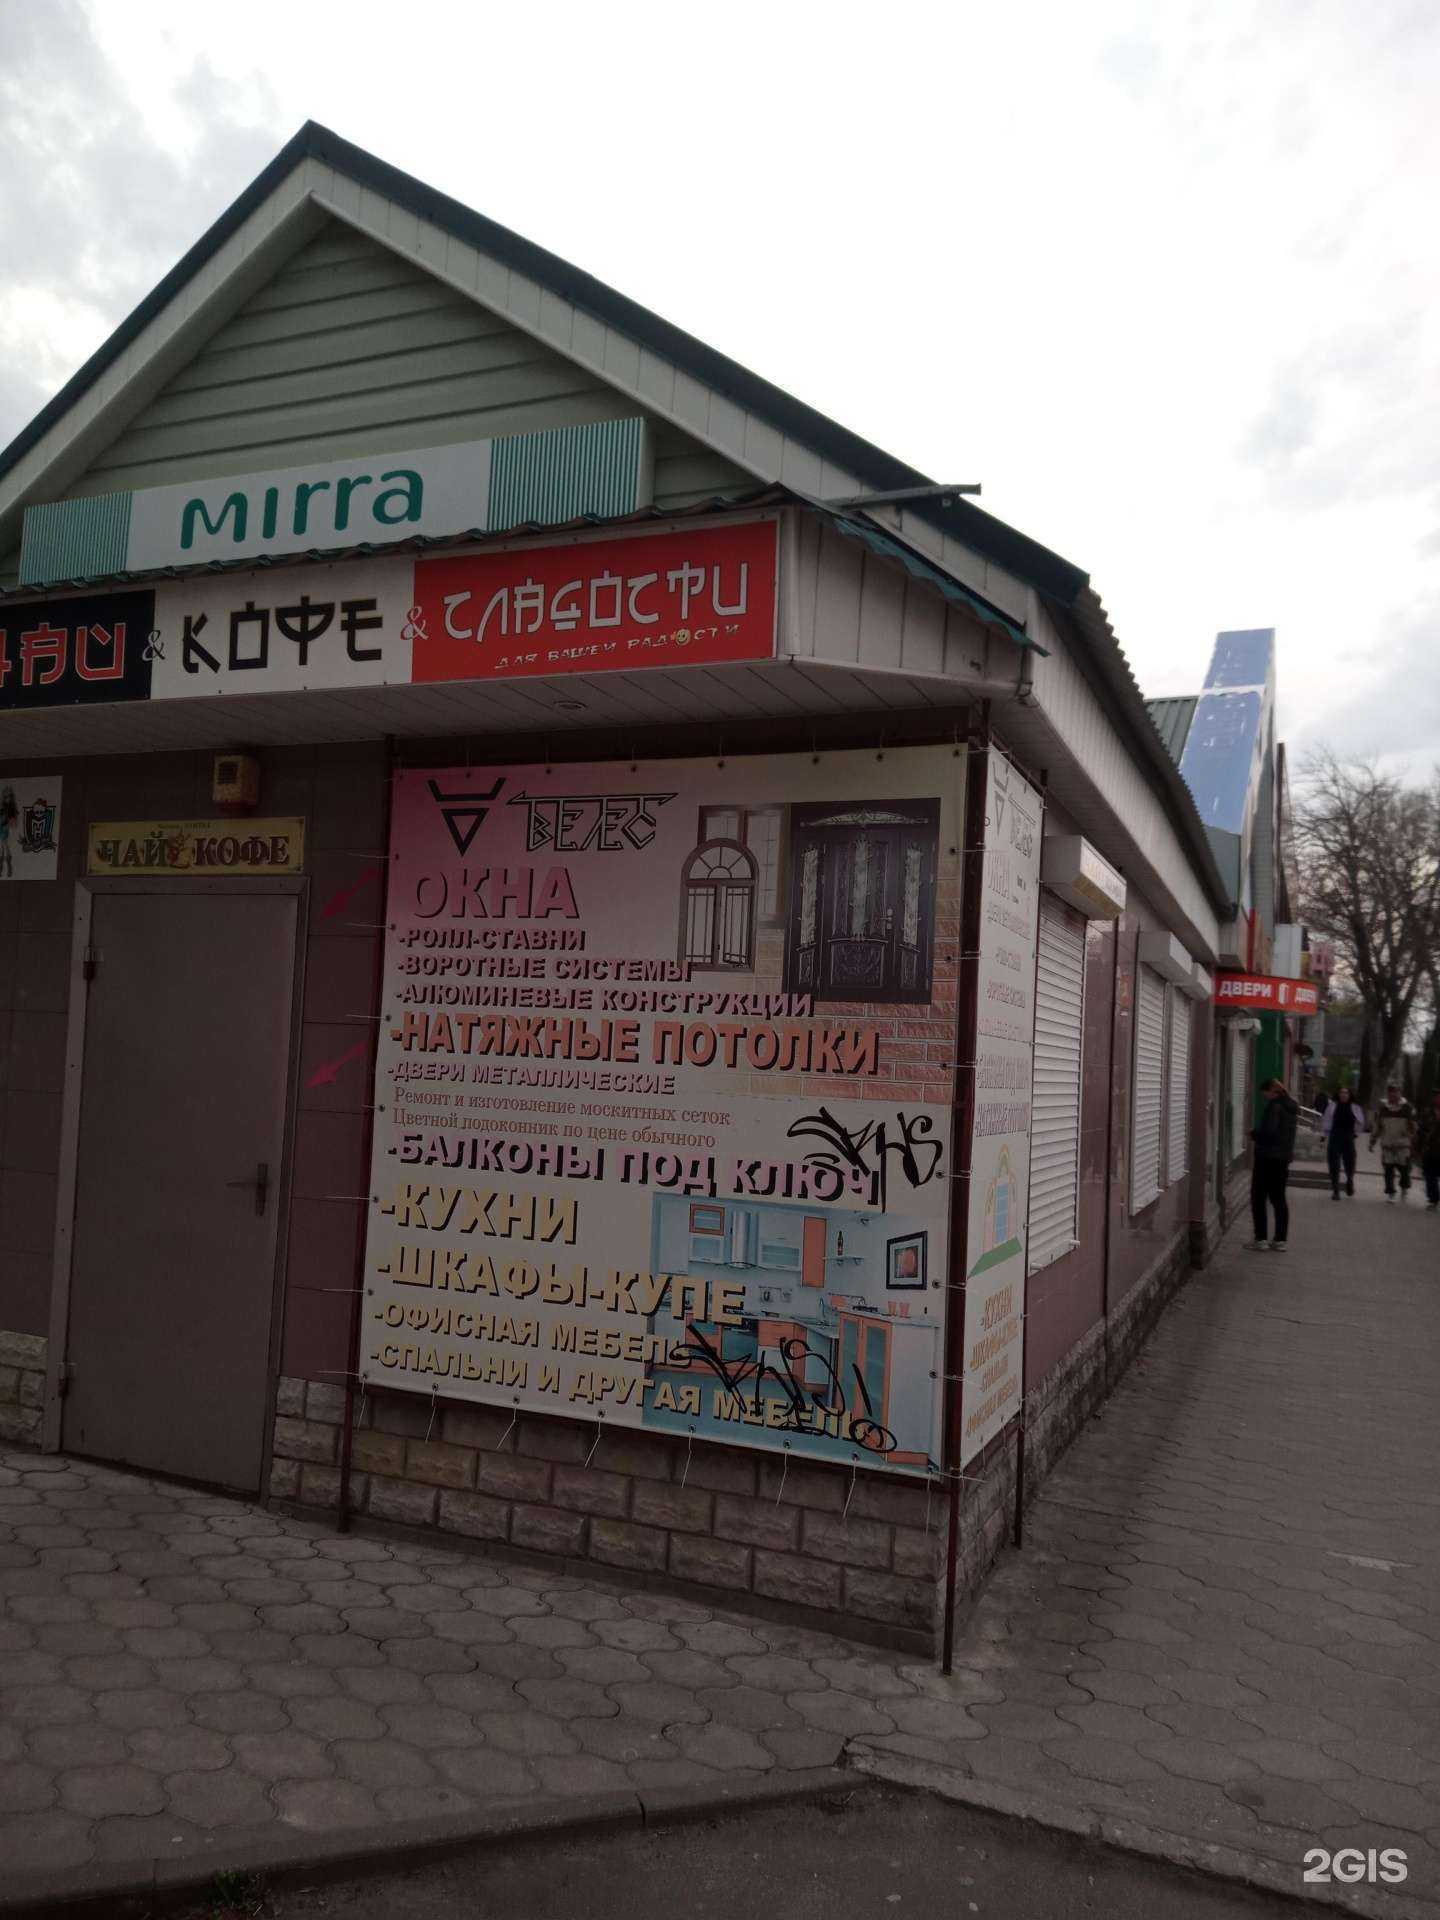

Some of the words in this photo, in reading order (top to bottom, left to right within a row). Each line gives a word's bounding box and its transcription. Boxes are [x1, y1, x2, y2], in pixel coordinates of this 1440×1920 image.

[142, 630, 166, 661] &
[183, 596, 384, 674] КОФЕ
[400, 606, 431, 643] &
[443, 561, 748, 643] СЛАДОСТИ
[97, 831, 169, 868] ЧАЙ
[194, 835, 290, 867] КОФЕ
[413, 866, 580, 919] ОКНА
[553, 958, 692, 984] СИСТЕМЫ
[1219, 980, 1272, 998] ДВЕРИ
[601, 990, 815, 1020] КОНСТРУКЦИИ
[653, 1020, 880, 1076] ПОТОЛКИ
[472, 1066, 676, 1095] МЕТАЛЛИЧЕСКИЕ
[394, 1086, 451, 1107] Ремонт
[453, 1094, 465, 1107] и
[468, 1095, 577, 1115] изготовление
[579, 1103, 677, 1122] москитных
[681, 1110, 731, 1126] сеток
[391, 1108, 459, 1128] Цветной
[460, 1115, 559, 1136] подоконник
[562, 1124, 584, 1138] по
[587, 1125, 628, 1142] цене
[631, 1127, 716, 1149] обычного
[615, 1145, 718, 1198] ПОД
[733, 1158, 880, 1206] КЛЮЧ
[551, 1321, 692, 1368] МЕБЕЛЬ
[537, 1365, 561, 1394] И
[568, 1370, 701, 1416] ДРУГАЯ
